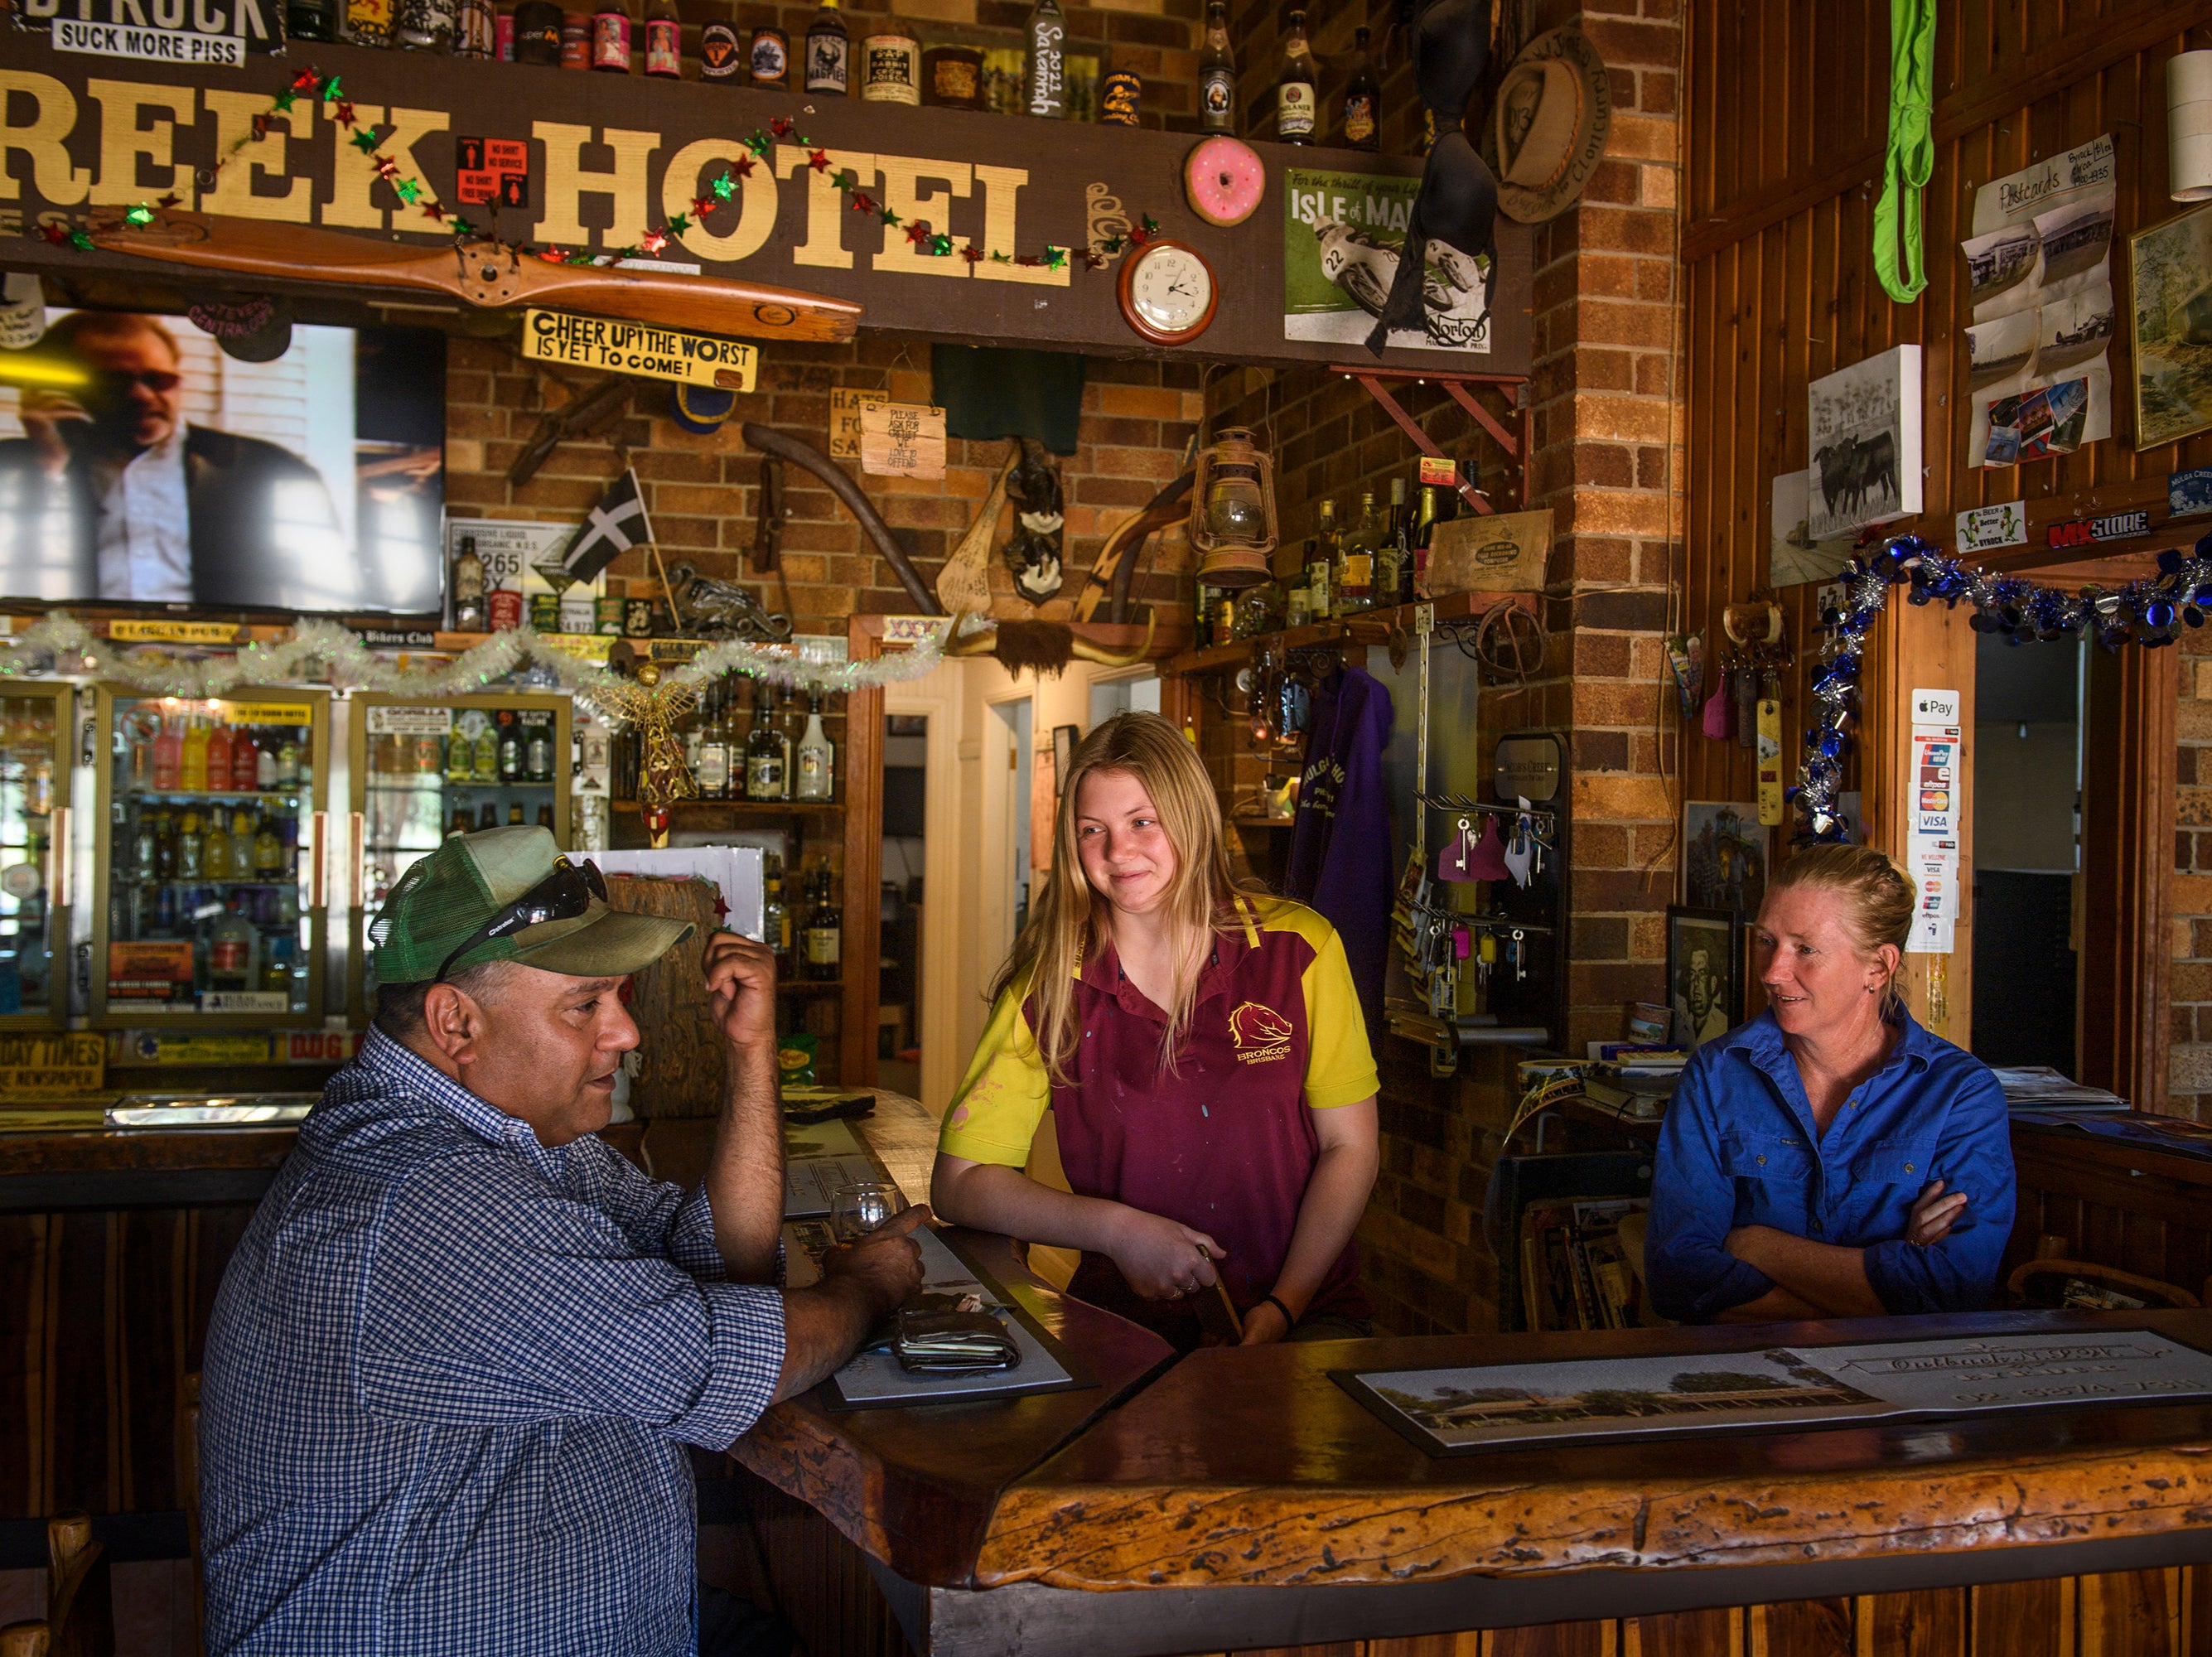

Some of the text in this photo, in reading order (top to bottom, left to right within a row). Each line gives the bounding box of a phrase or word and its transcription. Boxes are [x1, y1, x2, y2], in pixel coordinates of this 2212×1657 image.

[60, 23, 237, 64] SUCK MORE PISS
[1292, 173, 1309, 186] For
[1311, 175, 1328, 187] the
[1331, 177, 1359, 191] thrill
[1999, 166, 2060, 210] Postcards
[532, 120, 1072, 287] HOTEL
[1291, 188, 1347, 225] ISLE
[1350, 201, 1363, 222] of
[1326, 249, 1344, 272] 22
[533, 312, 606, 345] CHEER
[645, 330, 676, 355] THE
[680, 336, 751, 365] WORST
[1426, 315, 1486, 346] Norton
[537, 336, 553, 357] IS
[556, 338, 594, 363] YET
[599, 345, 622, 366] TO
[891, 408, 920, 421] PLEASE
[888, 420, 920, 432] ASK FOR
[831, 437, 859, 455] SA
[890, 448, 908, 457] LOVE
[887, 457, 917, 468] OFFEND
[2171, 473, 2194, 487] MULGA
[1983, 508, 1999, 516] BEER
[1980, 518, 1999, 527] Better
[1979, 536, 2003, 547] BYROCK
[481, 553, 519, 574] 265
[366, 630, 404, 643] Bikers
[406, 631, 433, 644] Club
[1930, 699, 1953, 717] Pay
[1923, 816, 1947, 827] VISA
[43, 1036, 101, 1067] TIMES
[1237, 1046, 1292, 1061] BRONCOS
[1247, 1053, 1286, 1065] BRISBANE
[16, 1069, 95, 1088] NEWSPAPER
